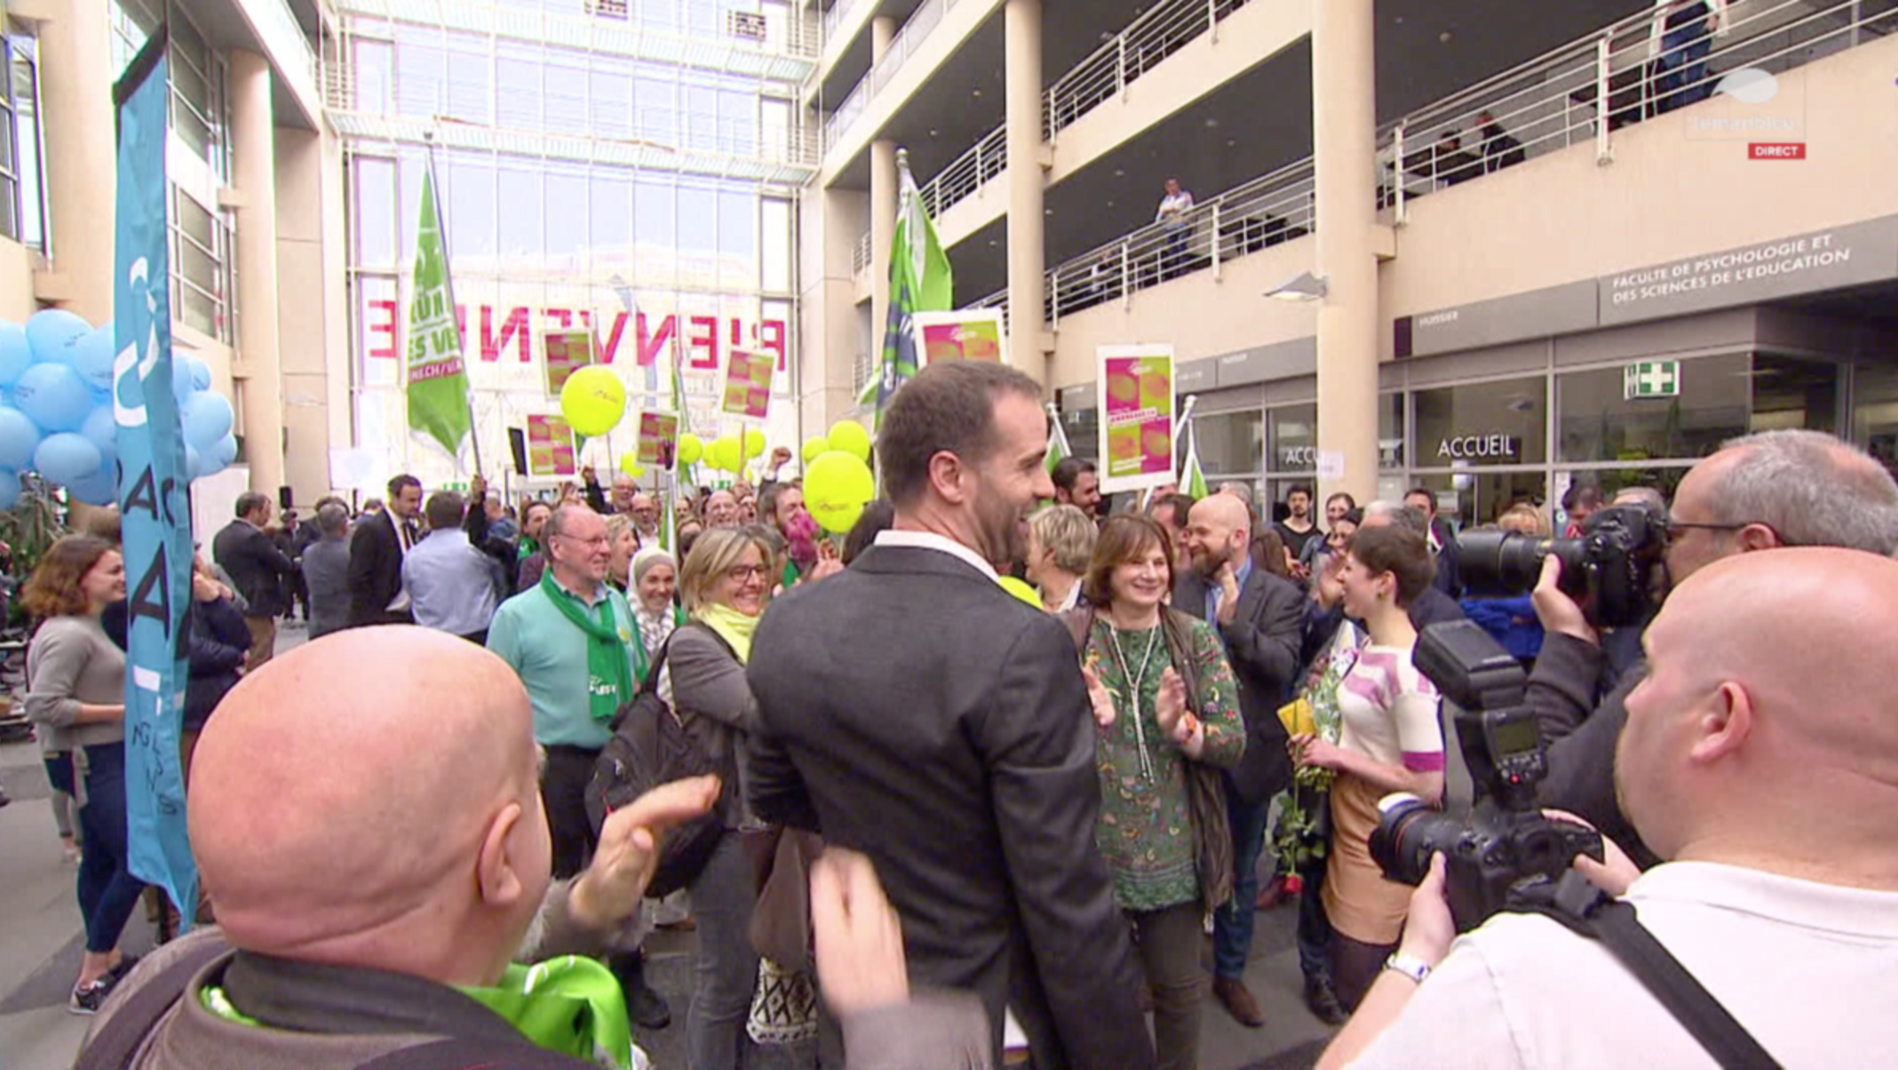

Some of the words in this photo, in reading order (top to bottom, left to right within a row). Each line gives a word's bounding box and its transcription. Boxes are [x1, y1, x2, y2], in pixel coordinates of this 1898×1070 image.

[1611, 288, 1637, 305] DES
[1640, 277, 1707, 300] SCIENCES
[1711, 271, 1731, 286] DE
[1735, 248, 1851, 282] L'EDUCATION
[1612, 268, 1669, 289] FACULTE
[1672, 262, 1690, 277] DE
[1694, 238, 1806, 273] PSYCHOLOGIE
[1811, 234, 1832, 250] ET
[1285, 446, 1319, 465] ACCU
[1437, 433, 1514, 457] ACCUEIL
